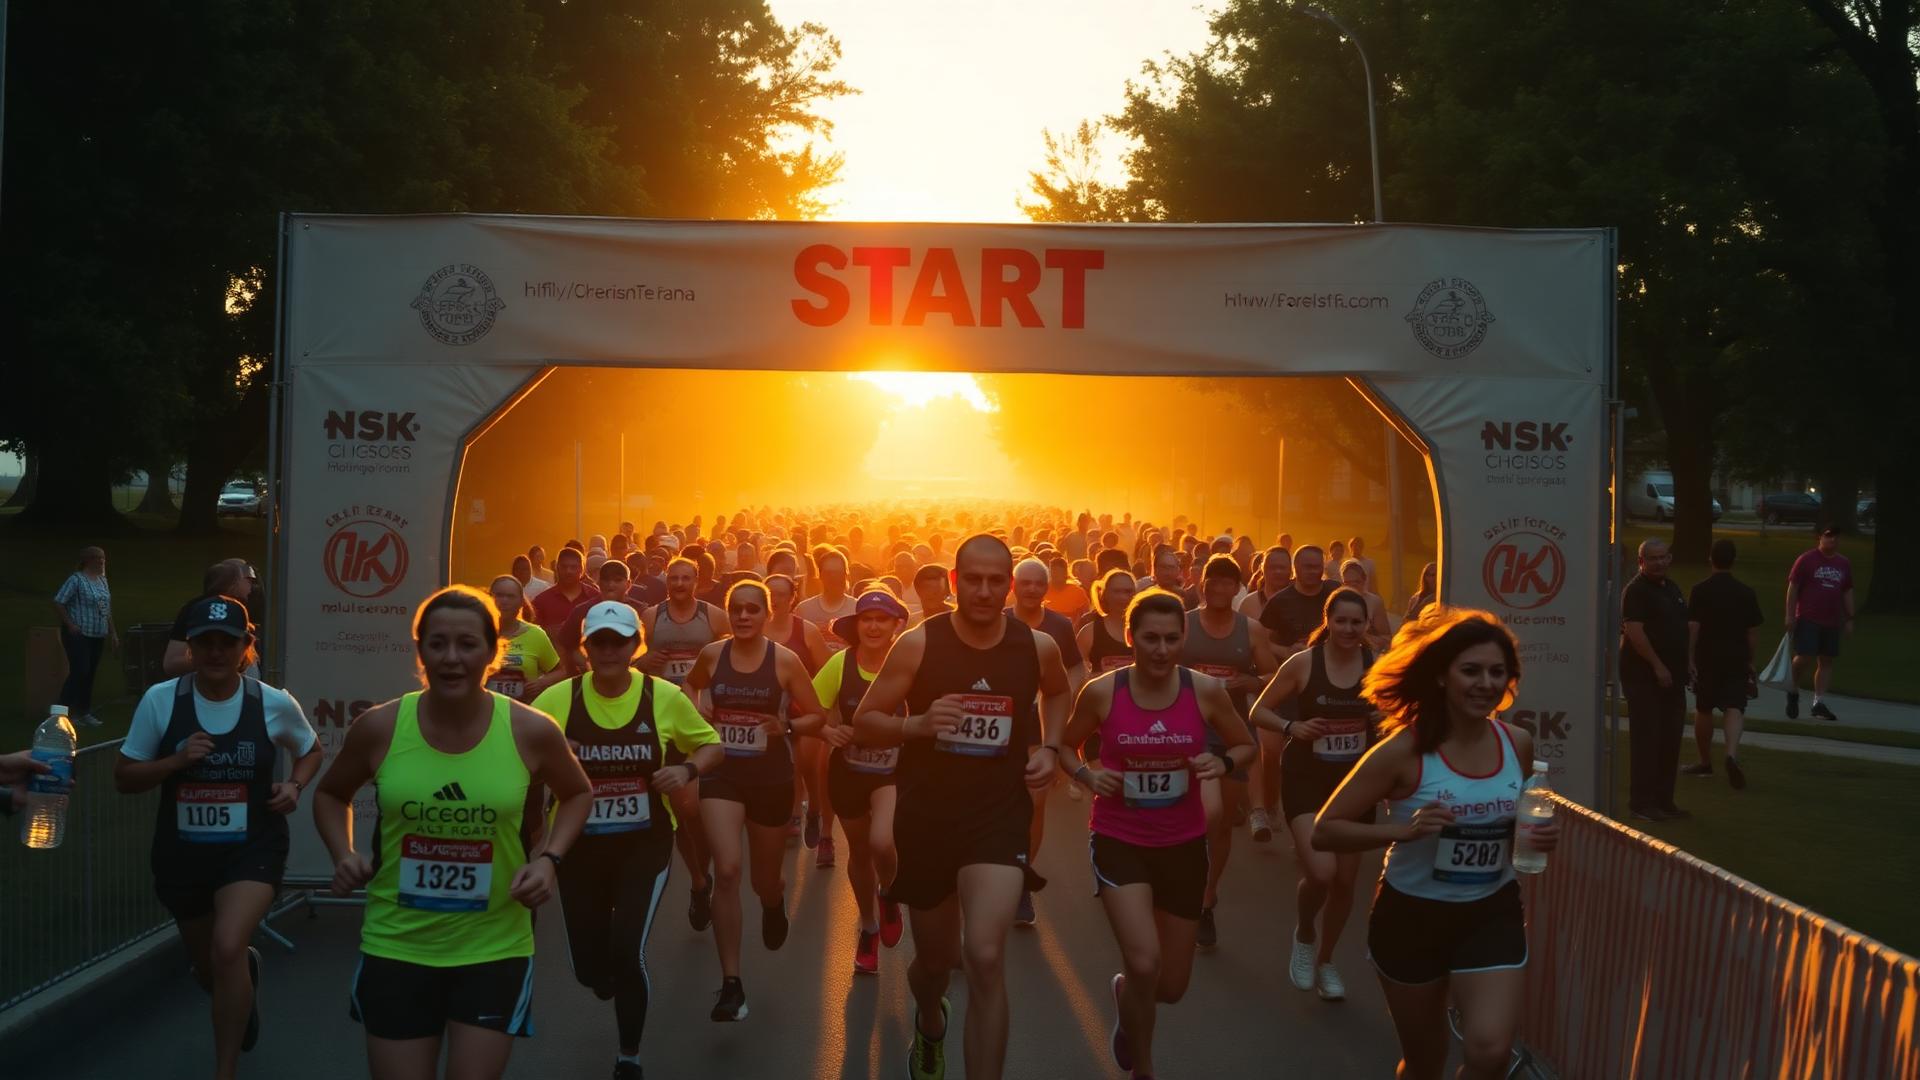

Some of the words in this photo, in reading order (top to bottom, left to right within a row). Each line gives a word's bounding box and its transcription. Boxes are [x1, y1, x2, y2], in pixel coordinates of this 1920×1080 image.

[791, 243, 1105, 329] START
[187, 806, 230, 826] 1105
[595, 796, 639, 818] 1753
[415, 863, 477, 891] 1325
